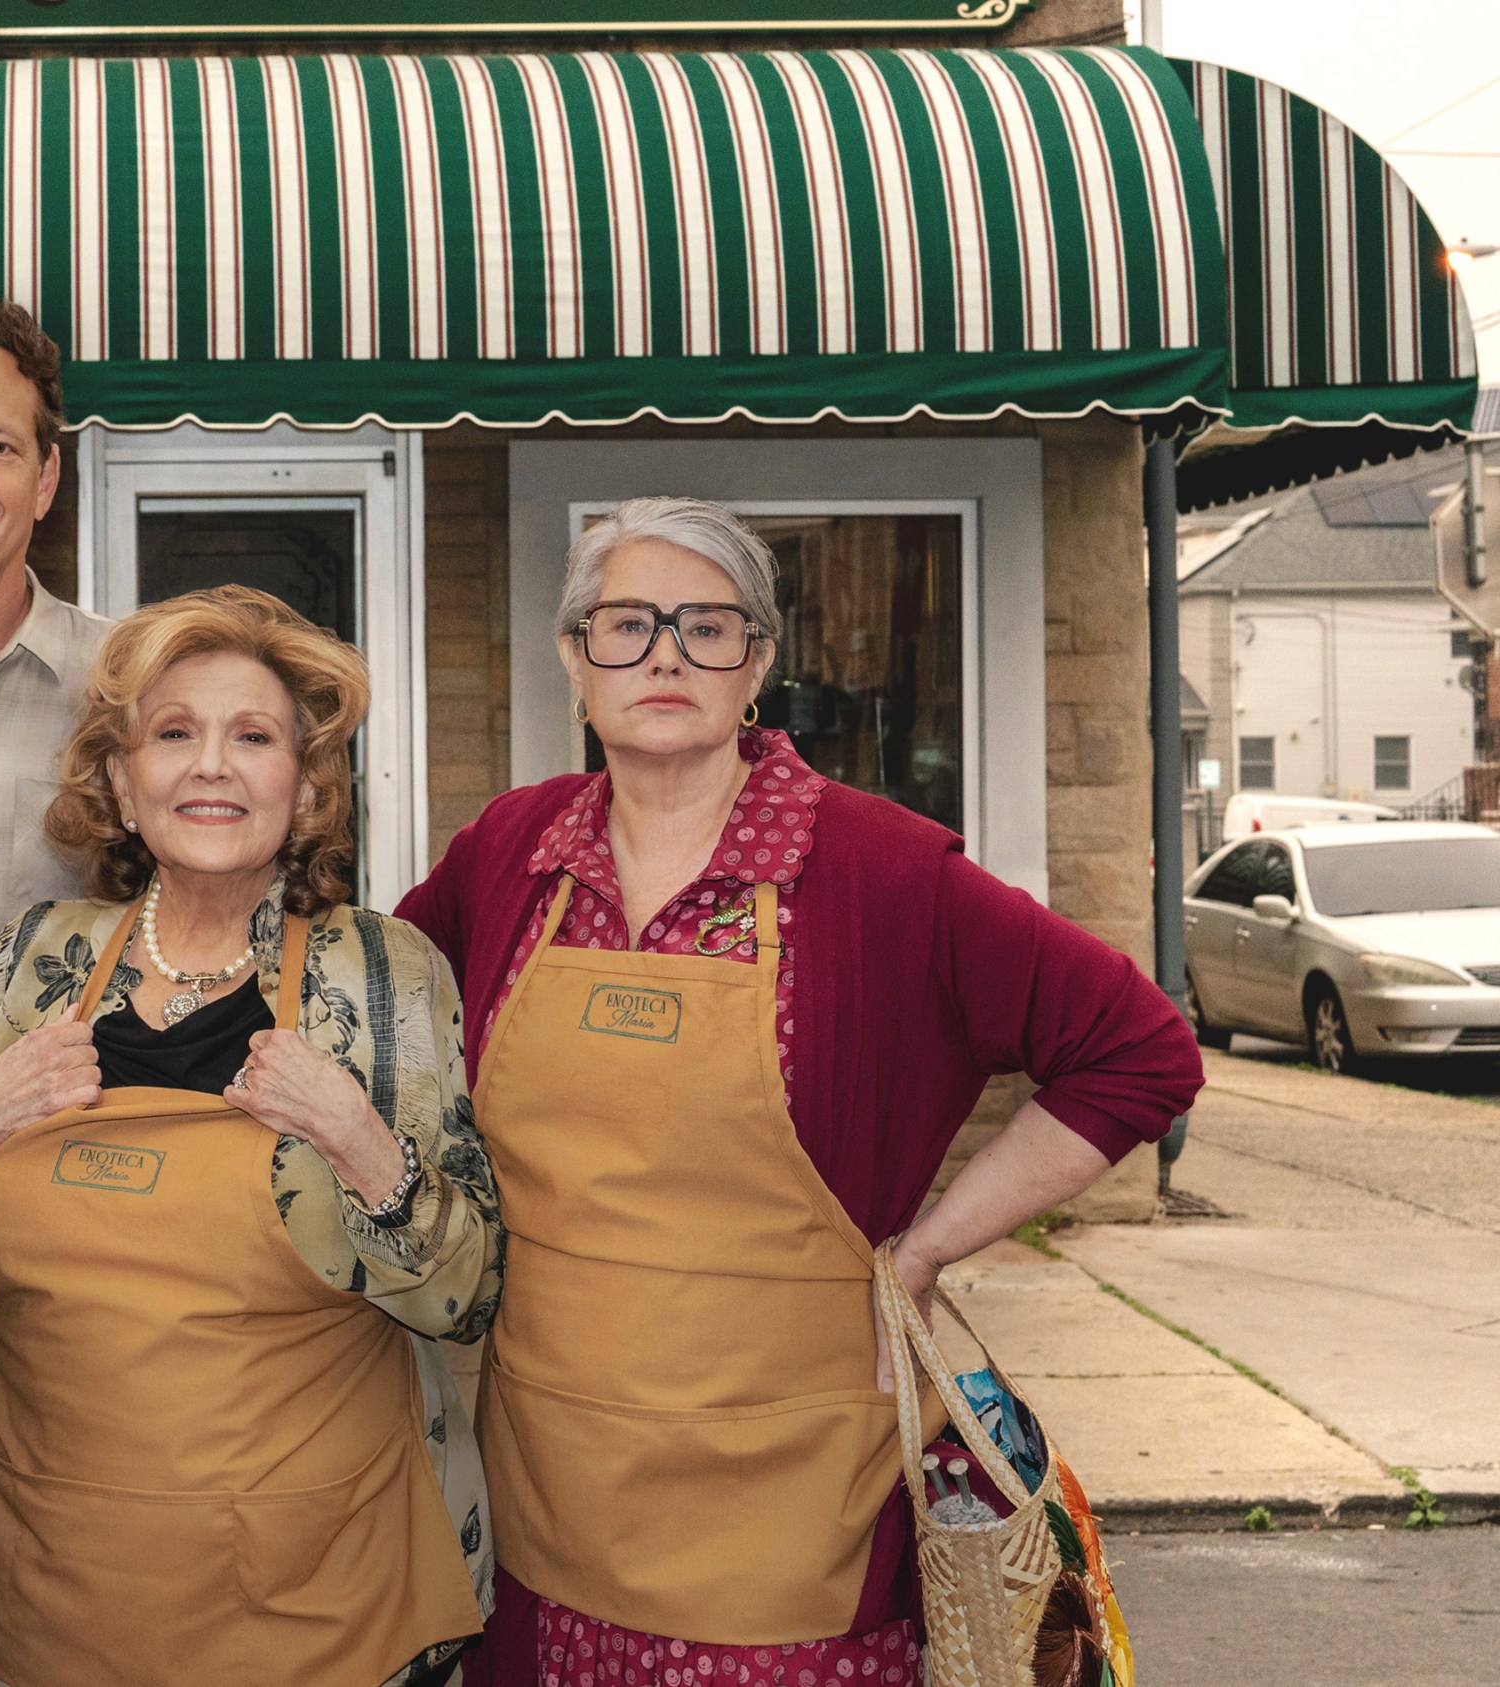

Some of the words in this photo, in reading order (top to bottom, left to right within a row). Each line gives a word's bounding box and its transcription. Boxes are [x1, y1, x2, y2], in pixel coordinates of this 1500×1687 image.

[606, 993, 667, 1014] ENOTECA
[606, 1009, 656, 1029] Maria
[78, 1148, 145, 1168] ENOTECA
[79, 1163, 131, 1182] Maria
